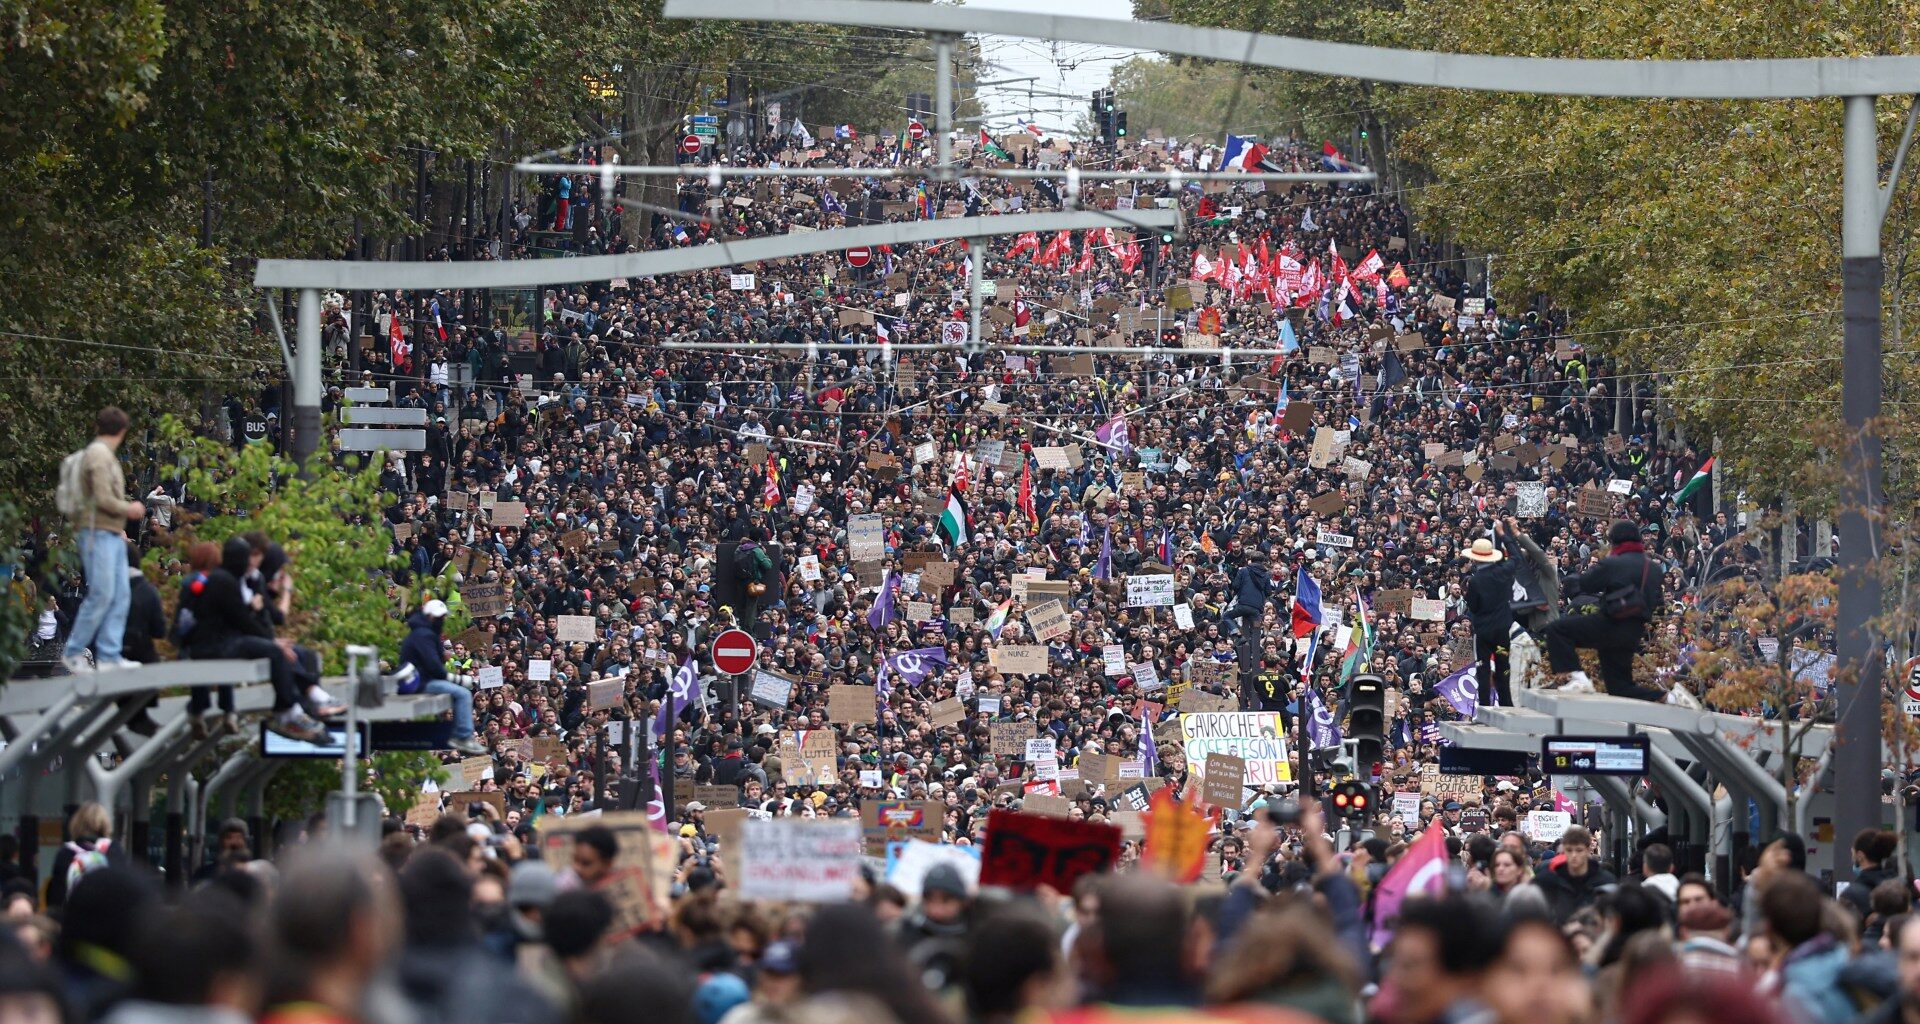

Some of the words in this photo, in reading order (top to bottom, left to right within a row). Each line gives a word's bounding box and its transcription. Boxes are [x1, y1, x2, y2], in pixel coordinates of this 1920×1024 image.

[246, 421, 265, 432] BUS
[1323, 535, 1348, 545] BONJOUR
[1265, 681, 1275, 698] 9
[1184, 714, 1258, 738] GAVROCHE
[805, 749, 834, 759] LUTTE
[1555, 757, 1566, 766] 13
[1574, 758, 1590, 767] +60
[1250, 761, 1290, 783] RUE
[1422, 764, 1435, 774] CE
[1423, 774, 1438, 782] EST
[1468, 775, 1479, 784] TA
[1437, 793, 1464, 802] CHIER
